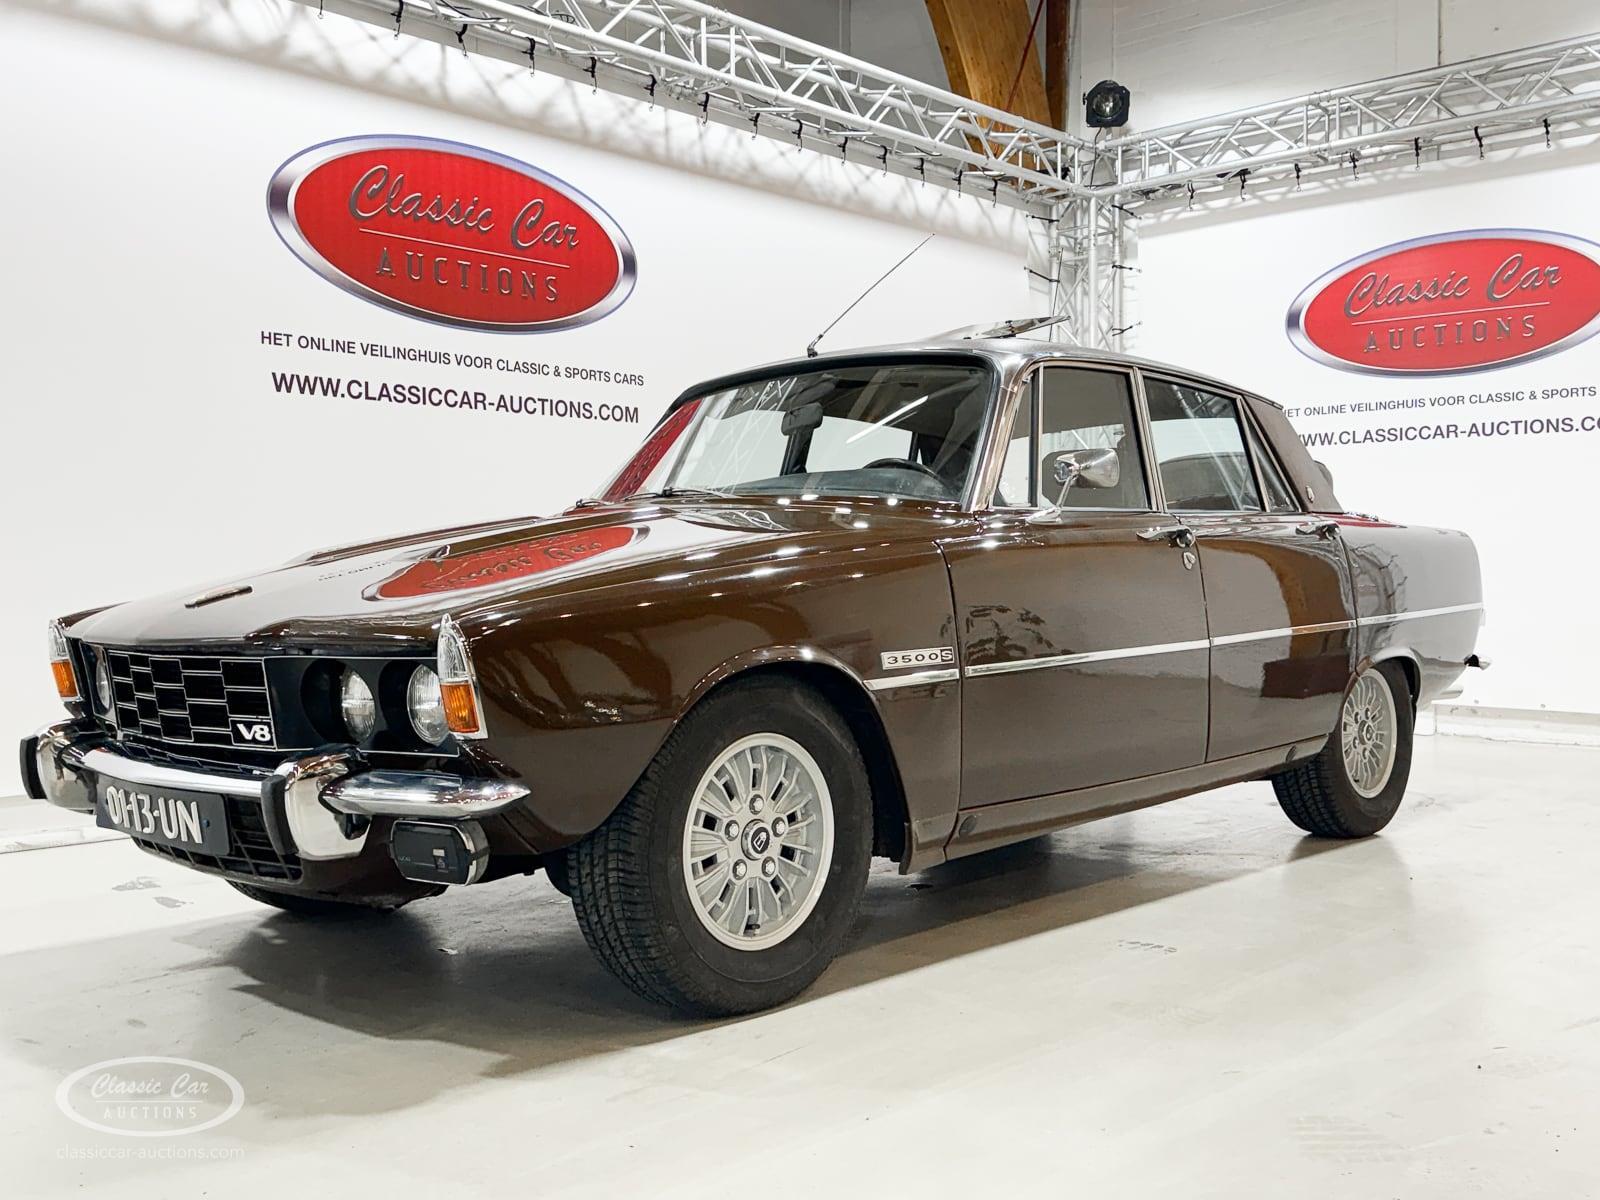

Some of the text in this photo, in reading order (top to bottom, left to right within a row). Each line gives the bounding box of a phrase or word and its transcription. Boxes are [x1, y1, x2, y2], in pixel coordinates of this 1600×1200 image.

[349, 164, 579, 250] Classic Car
[375, 247, 559, 302] AUCTIONS
[1344, 253, 1562, 318] Classic Car
[261, 330, 645, 387] HET ONLINE VEILINGHUIS VOOR CLASSIC & SPORTS CARS
[1363, 314, 1536, 354] AUCTIONS
[271, 371, 640, 424] WWW.CLASSICCAR-AUCTIONS.COM
[1303, 404, 1347, 417] ONLINE
[1350, 398, 1426, 413] VEILINGHUIS
[1429, 395, 1465, 407] VOOR
[1469, 391, 1525, 405] CLASSIC
[1528, 390, 1538, 401] &
[1541, 386, 1598, 400] SPORTS
[1299, 416, 1600, 447] WW.CLASSICCAR-AUCTIONS.C
[887, 650, 953, 665] 3500S
[236, 723, 272, 742] V8
[106, 785, 203, 844] 01-13-UN
